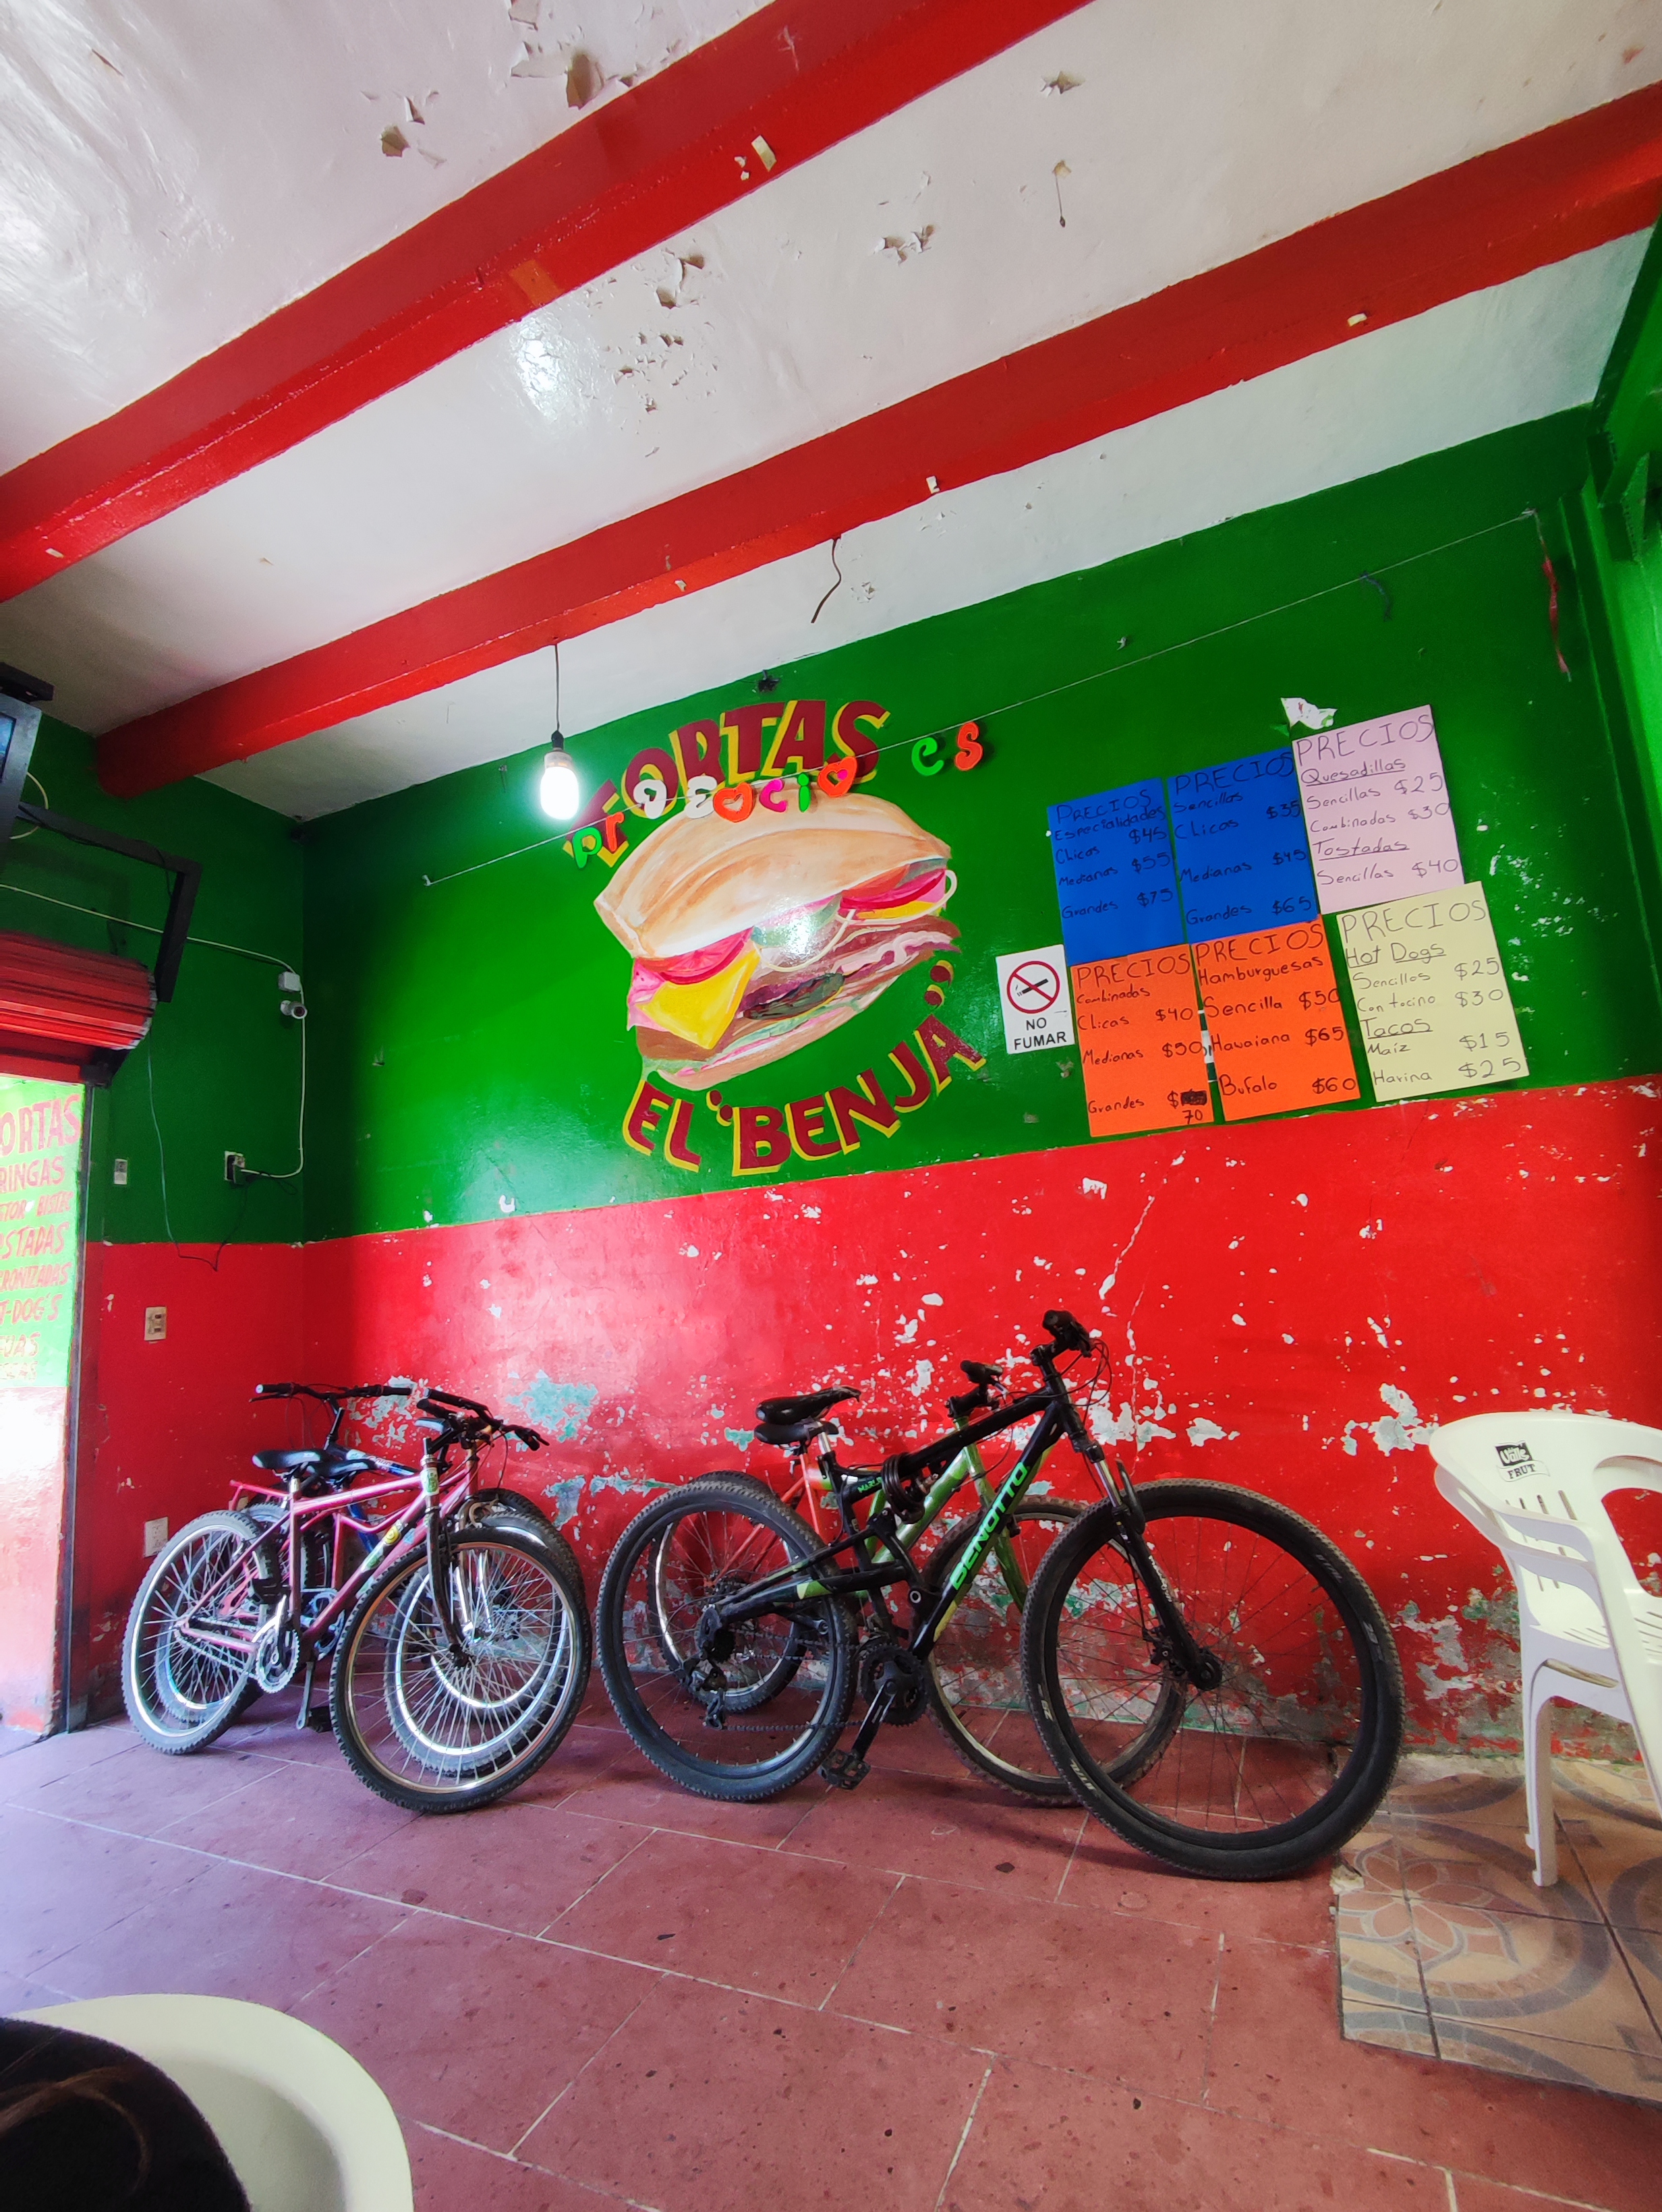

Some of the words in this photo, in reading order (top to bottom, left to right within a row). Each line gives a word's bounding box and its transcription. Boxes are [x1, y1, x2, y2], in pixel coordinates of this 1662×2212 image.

[1296, 714, 1433, 765] PRECIOS
[563, 700, 890, 867] TORTAS
[1175, 752, 1294, 795] PRECIOS
[1301, 758, 1406, 784] Quesadillas
[1307, 786, 1381, 809] Sencillas
[1394, 772, 1443, 794] $25
[1057, 790, 1151, 824] PRECIOS
[1266, 801, 1300, 819] $35
[1310, 810, 1396, 832] Combinadas
[1408, 803, 1450, 819] $30
[1055, 806, 1166, 841] Especialidades
[1128, 827, 1167, 844] $45
[1312, 837, 1410, 856] Tostadas
[1058, 867, 1118, 885] Medianas
[1132, 852, 1170, 873] $55
[1180, 863, 1252, 882] Medianas
[1273, 849, 1306, 865] $45
[1317, 863, 1394, 885] Sencillas
[1412, 859, 1458, 877] $40
[1062, 900, 1118, 919] Grandes
[1137, 888, 1173, 907] $75
[1186, 905, 1252, 925] Grandes
[1273, 896, 1311, 915] $65
[1342, 900, 1486, 943] PRECIOS
[1195, 924, 1323, 966] PRECIOS
[1346, 945, 1381, 966] Hot
[1391, 943, 1446, 964] Dogs
[1077, 954, 1190, 989] PRECIOS
[1198, 957, 1323, 985] Hamburguesas
[1352, 972, 1430, 989] Sencillos
[1454, 958, 1499, 981] $25
[1077, 984, 1151, 1004] Combinadas
[1203, 996, 1282, 1017] Sencilla
[1298, 989, 1340, 1010] $50
[1357, 997, 1383, 1012] Con
[1389, 993, 1435, 1008] tocino
[1455, 989, 1503, 1008] $30
[1026, 1018, 1046, 1030] NO
[1156, 1008, 1193, 1021] $40
[1360, 1017, 1433, 1037] Tacos
[1014, 1031, 1066, 1050] FUMAR
[1305, 1026, 1344, 1046] $65
[1459, 1032, 1510, 1051] $15
[1083, 1049, 1143, 1065] Medianas
[1162, 1042, 1204, 1057] $50
[1220, 1074, 1277, 1095] Bufalo
[1313, 1078, 1356, 1094] $60
[1373, 1070, 1432, 1085] Harina
[1458, 1057, 1520, 1078] $25
[1088, 1096, 1144, 1113] Grandes
[1182, 1109, 1203, 1124] 70
[622, 1079, 700, 1173] EL
[1508, 1464, 1536, 1479] FRUT
[950, 1461, 1028, 1590] BENOTTO
